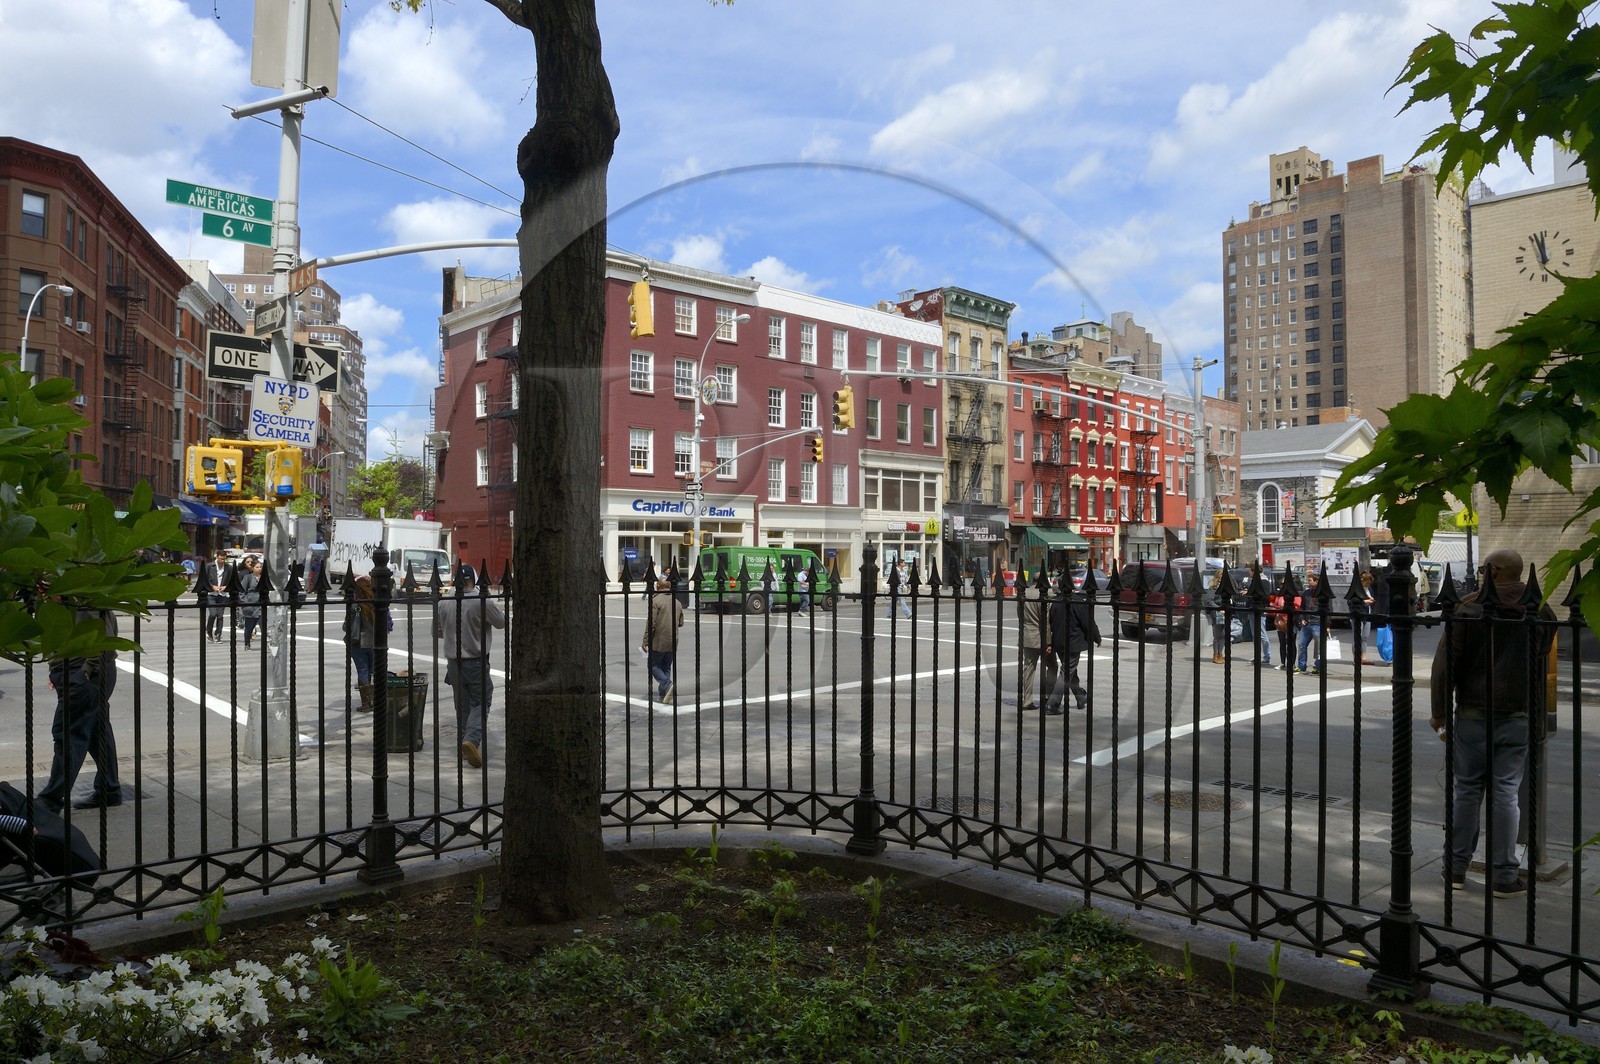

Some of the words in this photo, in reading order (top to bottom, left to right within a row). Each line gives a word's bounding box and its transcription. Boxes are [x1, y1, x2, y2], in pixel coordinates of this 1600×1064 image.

[188, 192, 255, 217] AMERICAS
[195, 186, 222, 197] AVENUE
[225, 192, 234, 200] OF
[237, 195, 249, 203] THE
[222, 219, 234, 238] 6
[242, 222, 254, 233] AV
[291, 273, 297, 291] W
[299, 271, 304, 287] 4
[306, 264, 314, 283] ST
[221, 349, 259, 368] ONE
[293, 358, 326, 376] WAY
[264, 380, 309, 399] NYPD
[252, 409, 315, 430] SECURITY
[254, 423, 311, 443] CAMERA
[632, 499, 683, 514] Capital
[684, 501, 708, 516] Oe
[708, 506, 736, 517] Bank
